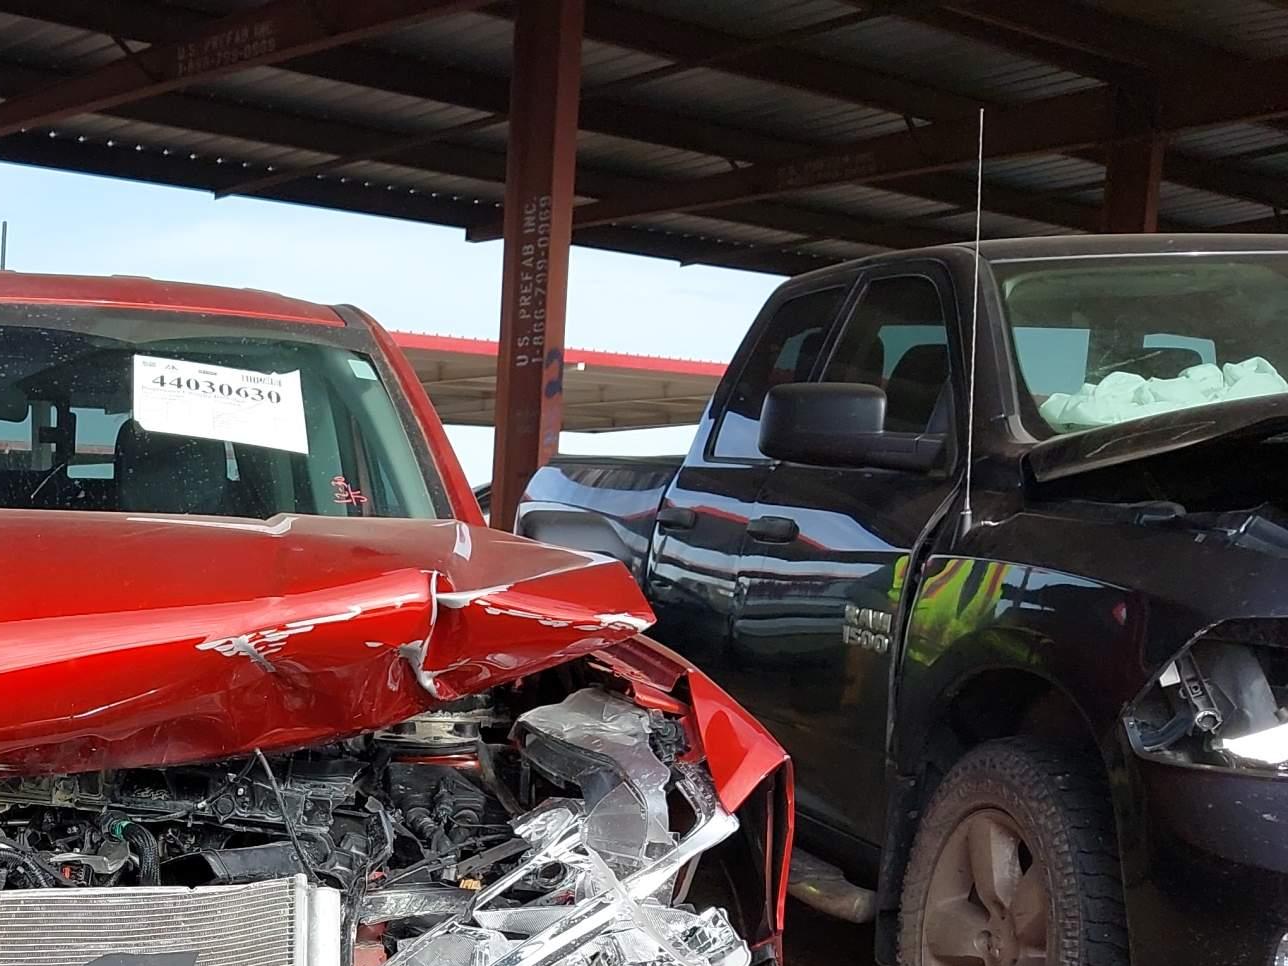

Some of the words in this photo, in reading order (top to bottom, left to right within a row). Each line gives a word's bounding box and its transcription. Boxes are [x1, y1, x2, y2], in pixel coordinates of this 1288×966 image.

[519, 243, 535, 320] PREFAB
[151, 374, 282, 404] 44030630
[845, 604, 892, 633] RAM
[843, 625, 890, 652] 1500
